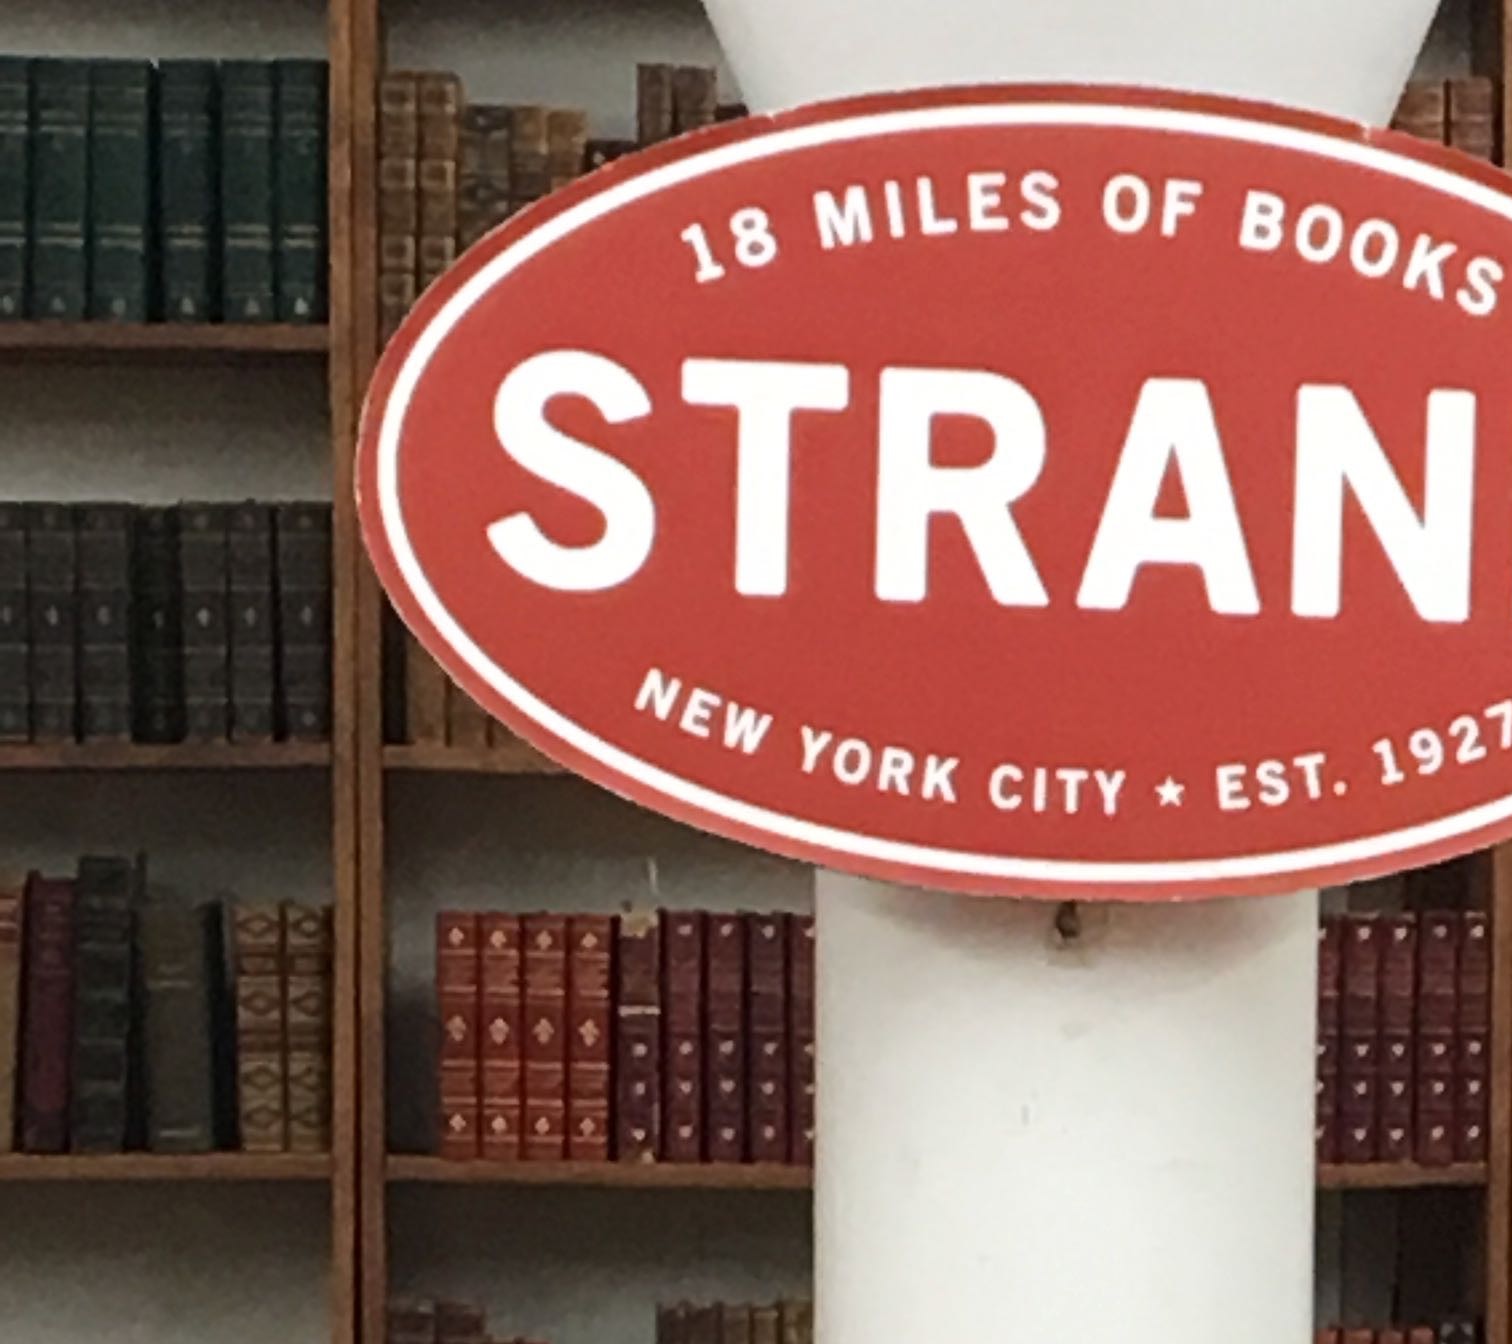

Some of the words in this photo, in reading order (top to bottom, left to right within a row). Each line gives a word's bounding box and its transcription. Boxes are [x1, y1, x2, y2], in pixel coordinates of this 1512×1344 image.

[680, 207, 778, 283] 18
[813, 171, 1061, 249] MILES
[1102, 174, 1203, 237] OF
[1239, 190, 1504, 316] BOOKS
[634, 668, 773, 754] NEW
[801, 726, 959, 803] YORK
[989, 764, 1126, 815] CITY
[1216, 752, 1347, 806] EST.
